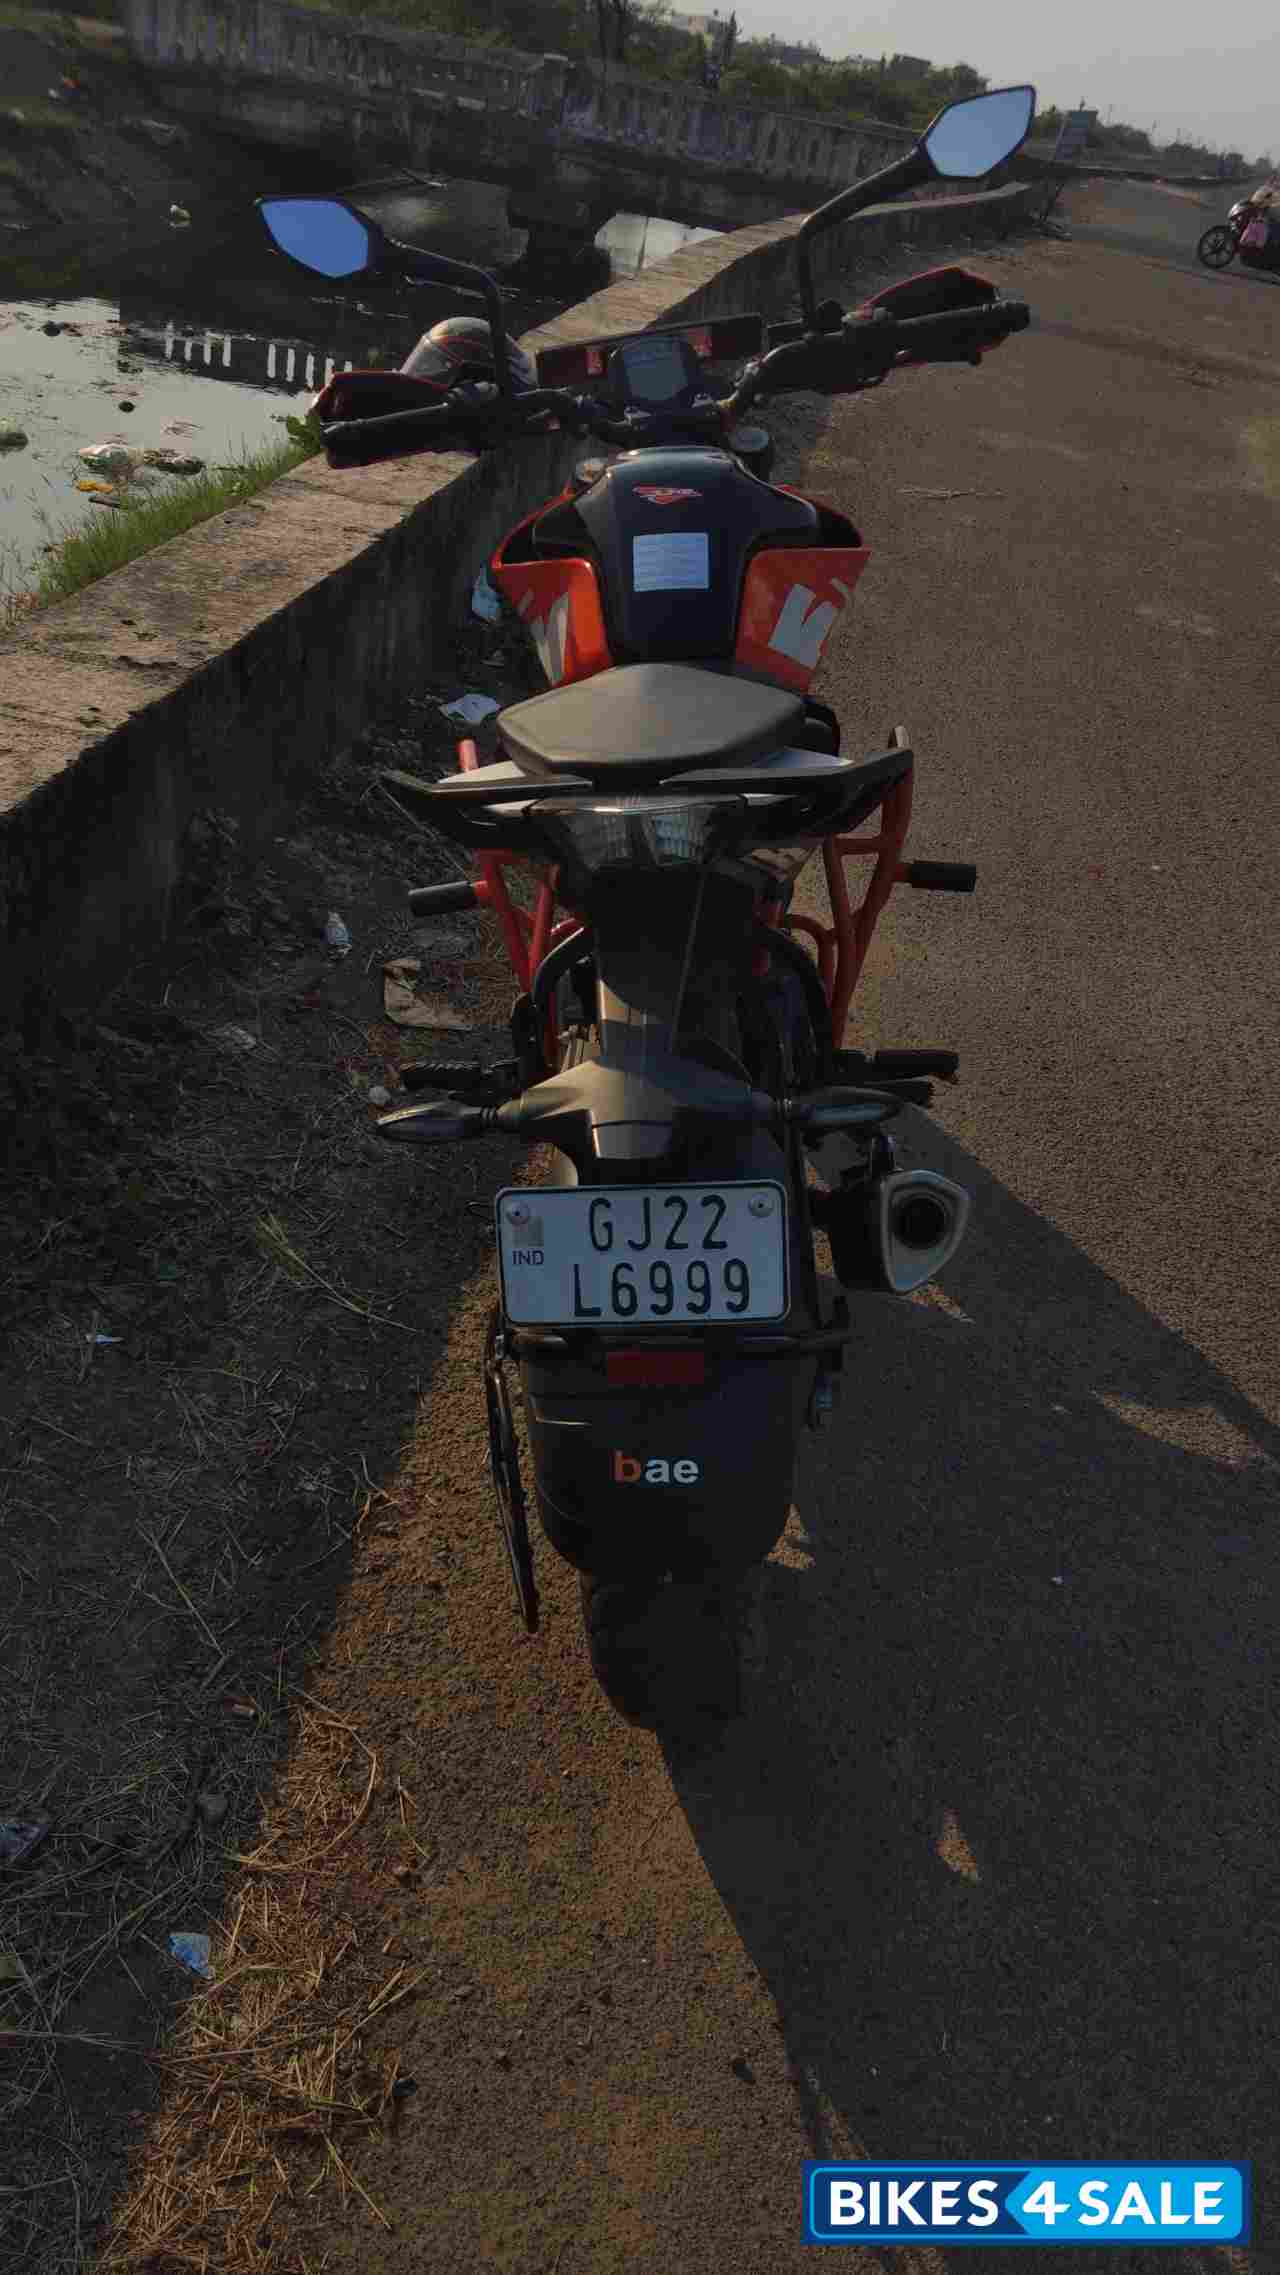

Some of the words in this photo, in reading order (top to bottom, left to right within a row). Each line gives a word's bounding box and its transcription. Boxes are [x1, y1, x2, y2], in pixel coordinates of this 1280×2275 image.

[588, 1194, 729, 1251] GJ22
[512, 1250, 544, 1265] IND
[573, 1258, 750, 1317] L6999
[613, 1448, 699, 1485] bae
